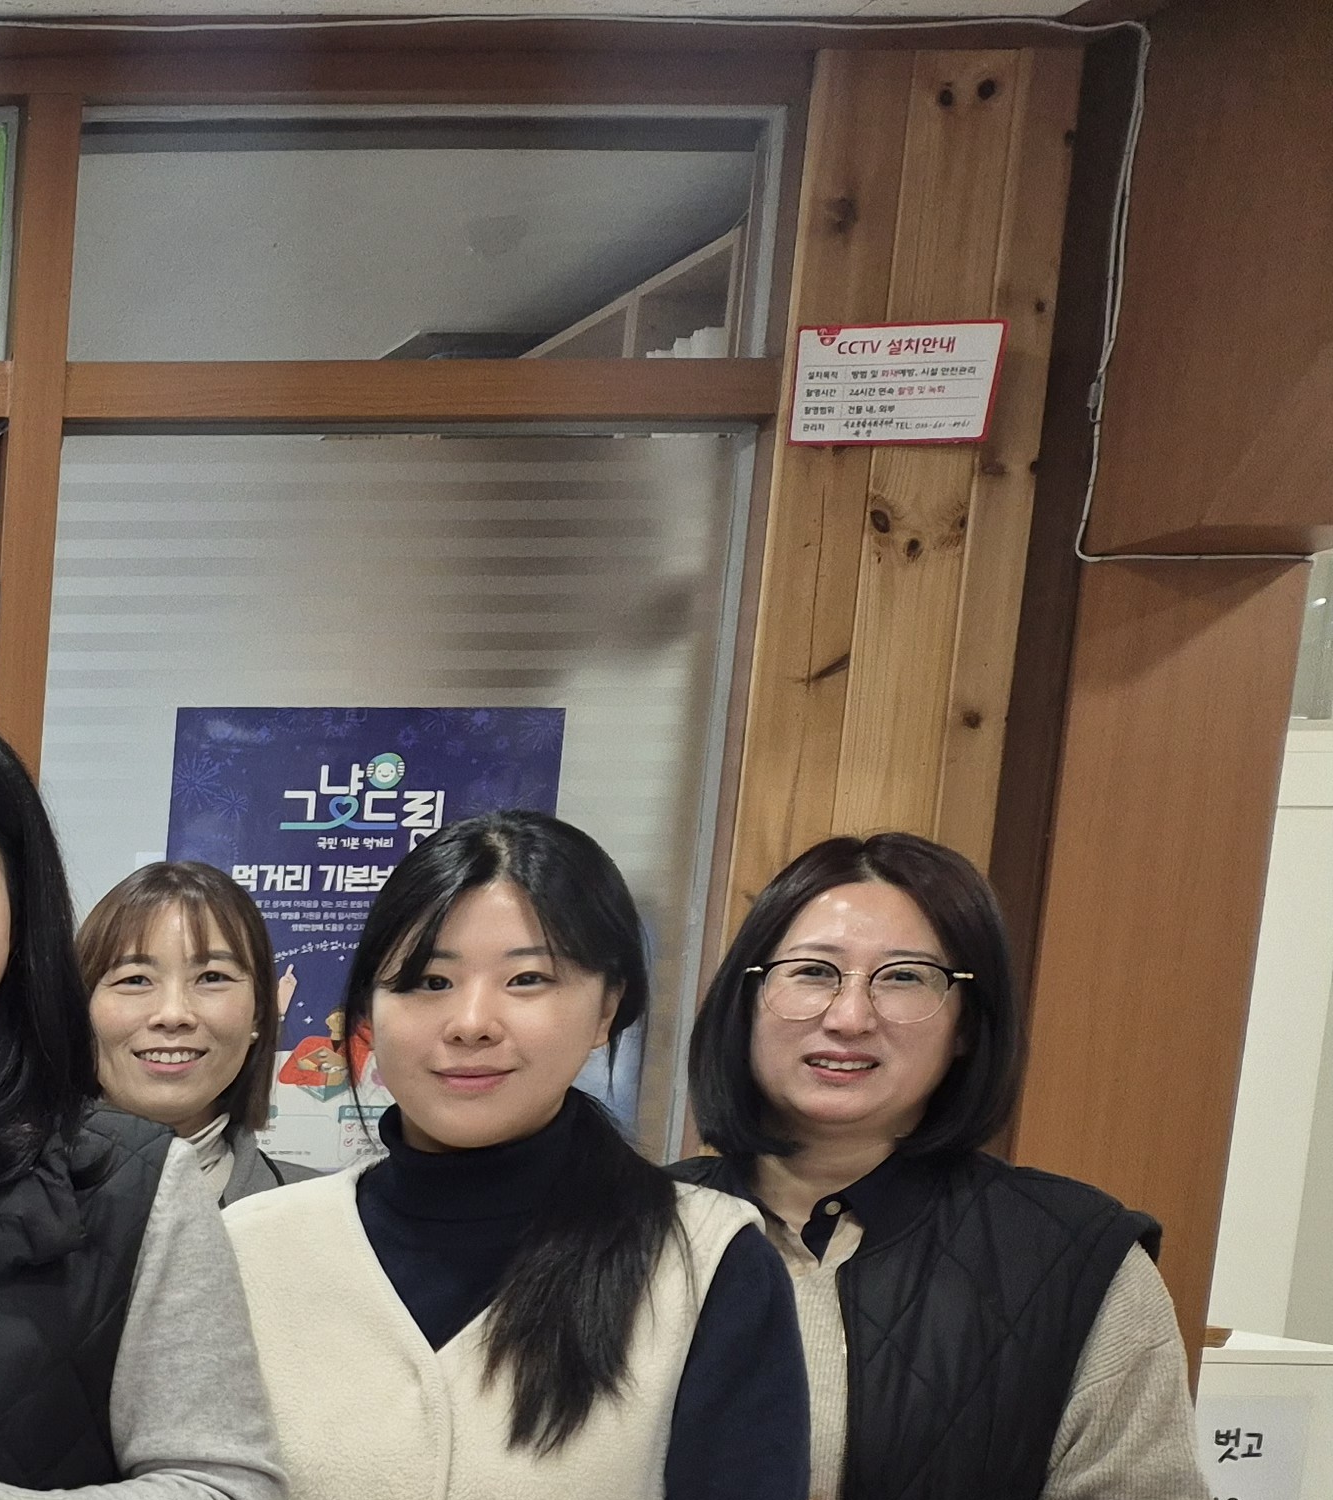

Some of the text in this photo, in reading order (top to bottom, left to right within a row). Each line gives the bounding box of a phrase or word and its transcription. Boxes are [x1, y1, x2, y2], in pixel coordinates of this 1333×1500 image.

[837, 336, 957, 355] CCTV 설치안내
[317, 837, 394, 850] 국민 기본 먹거리
[232, 864, 398, 892] 먹거리 기본보
[1214, 1427, 1264, 1464] 벗고
